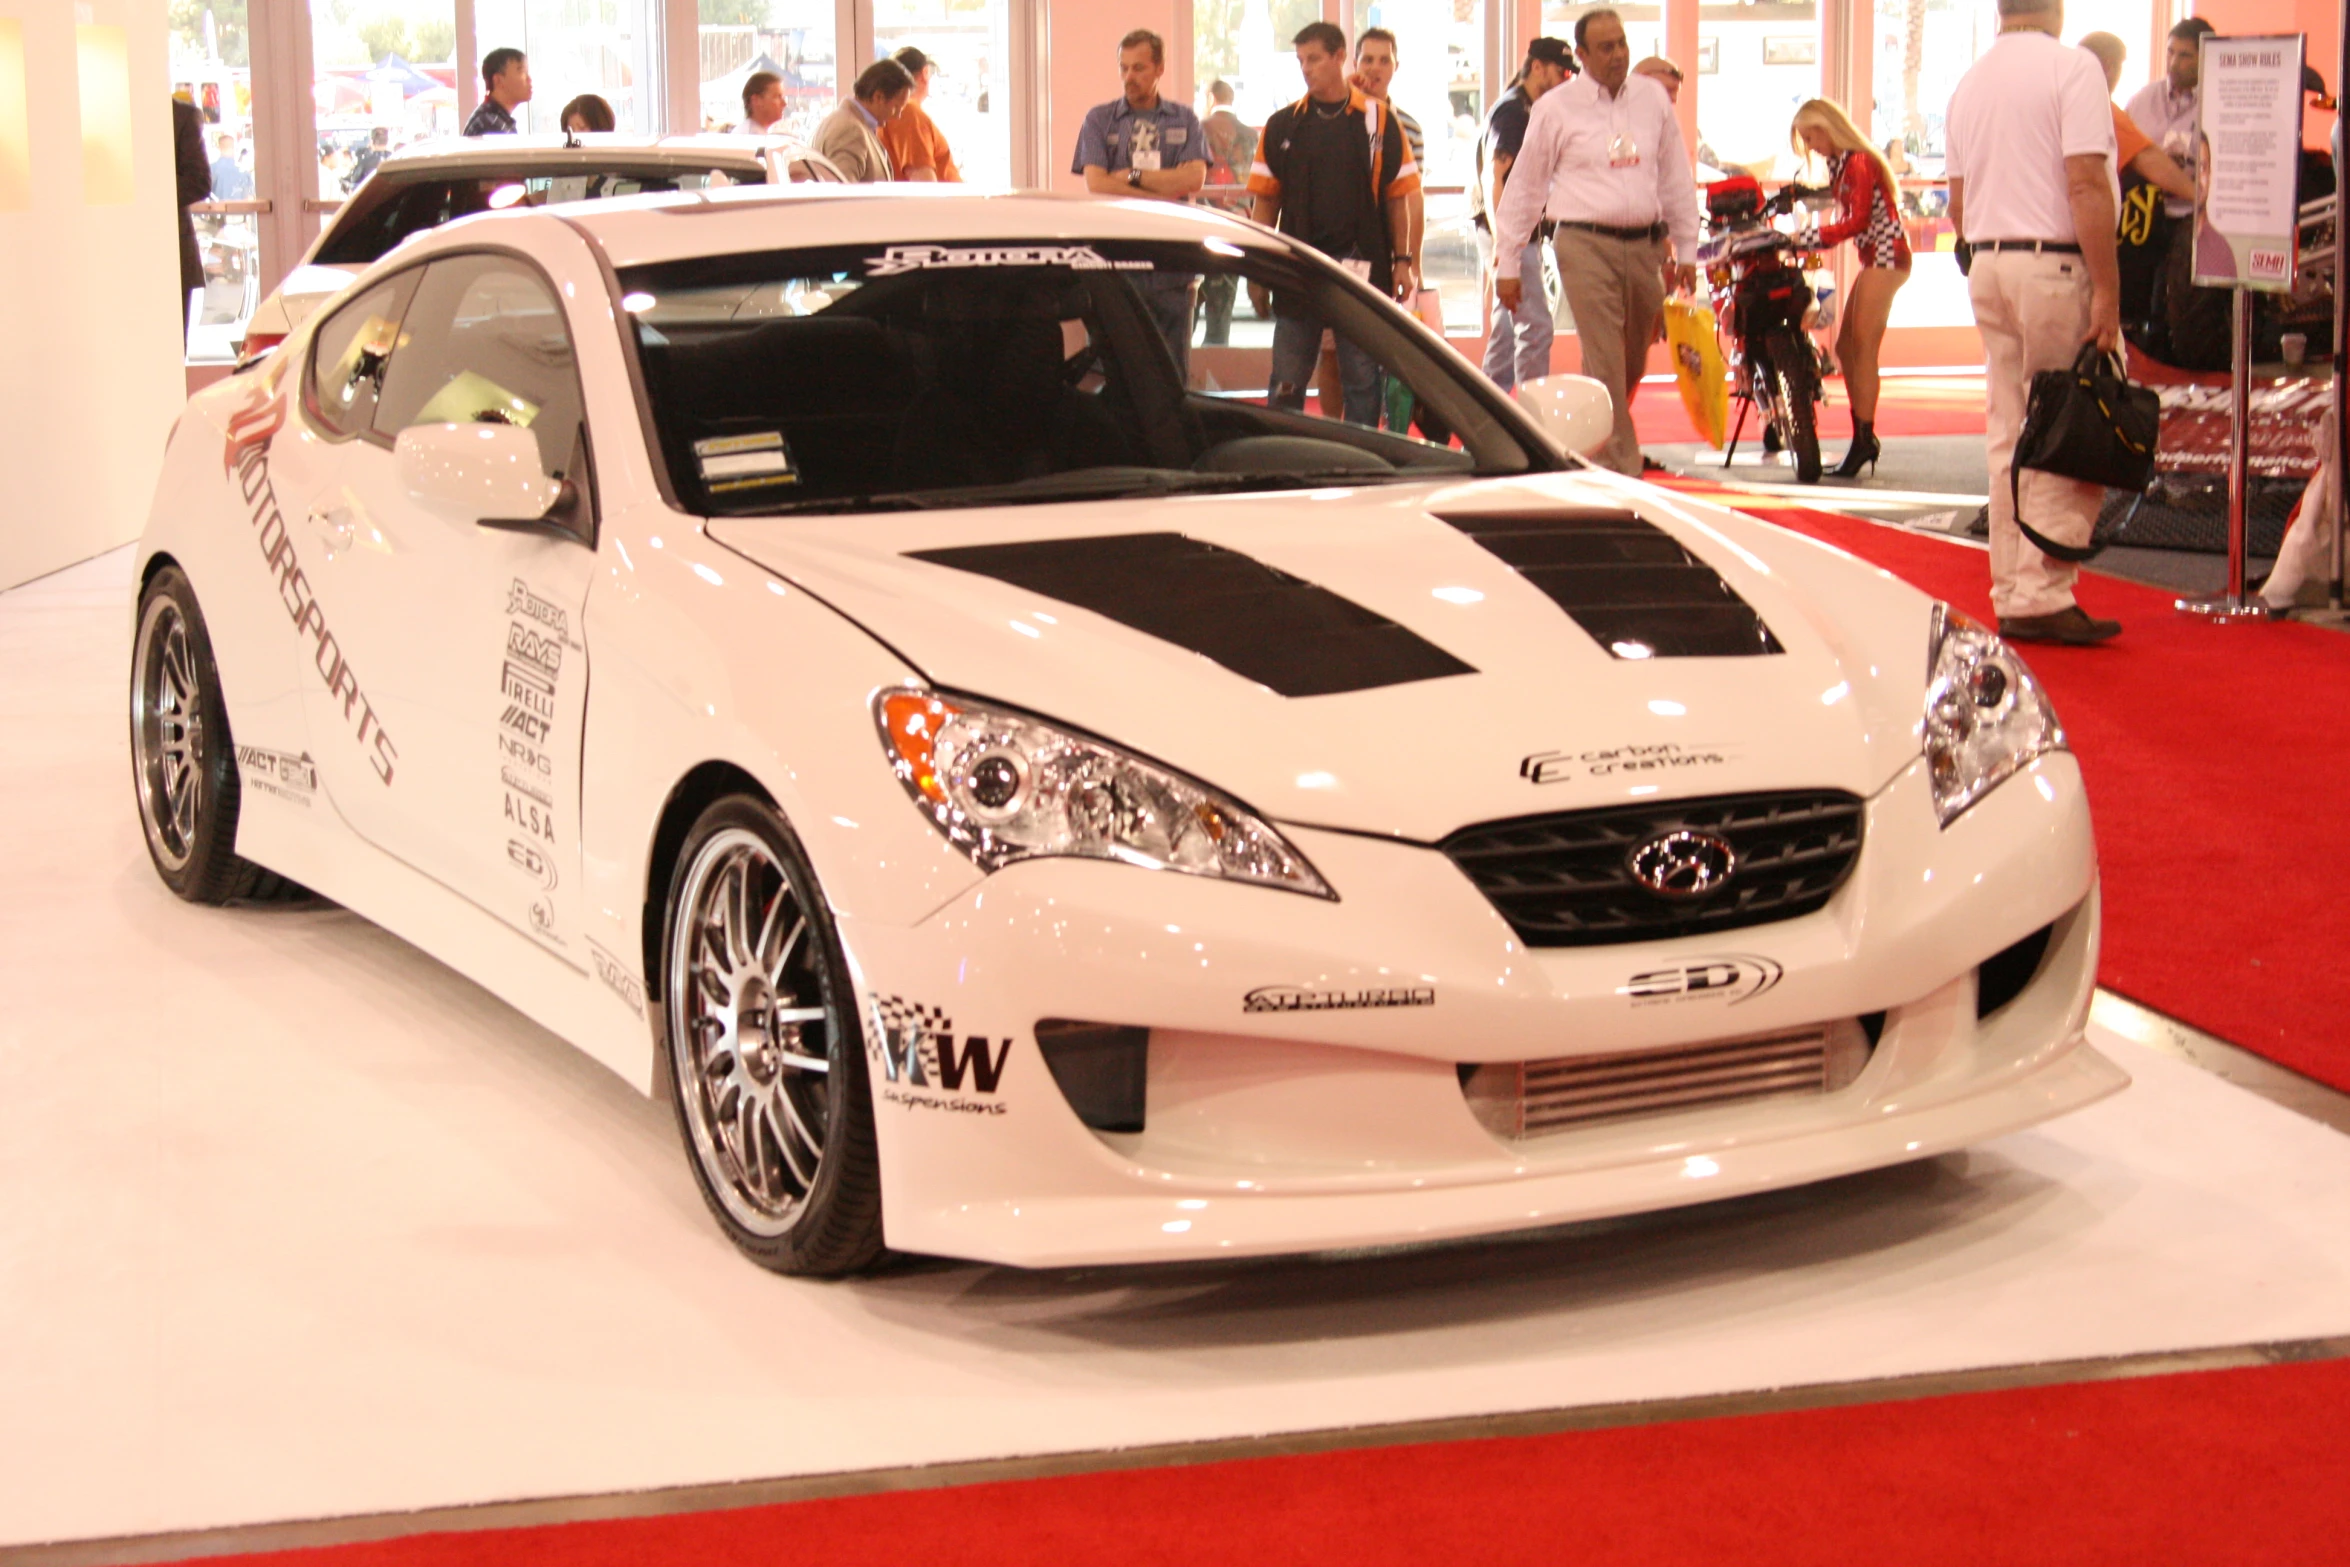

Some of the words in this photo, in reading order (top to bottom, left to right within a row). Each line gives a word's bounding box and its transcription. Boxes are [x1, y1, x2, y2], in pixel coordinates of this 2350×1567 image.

[501, 660, 556, 720] PIRELLI
[1580, 743, 1681, 763] carbon
[1589, 753, 1724, 776] creations
[505, 791, 555, 844] ALSA
[886, 1028, 1014, 1094] KW
